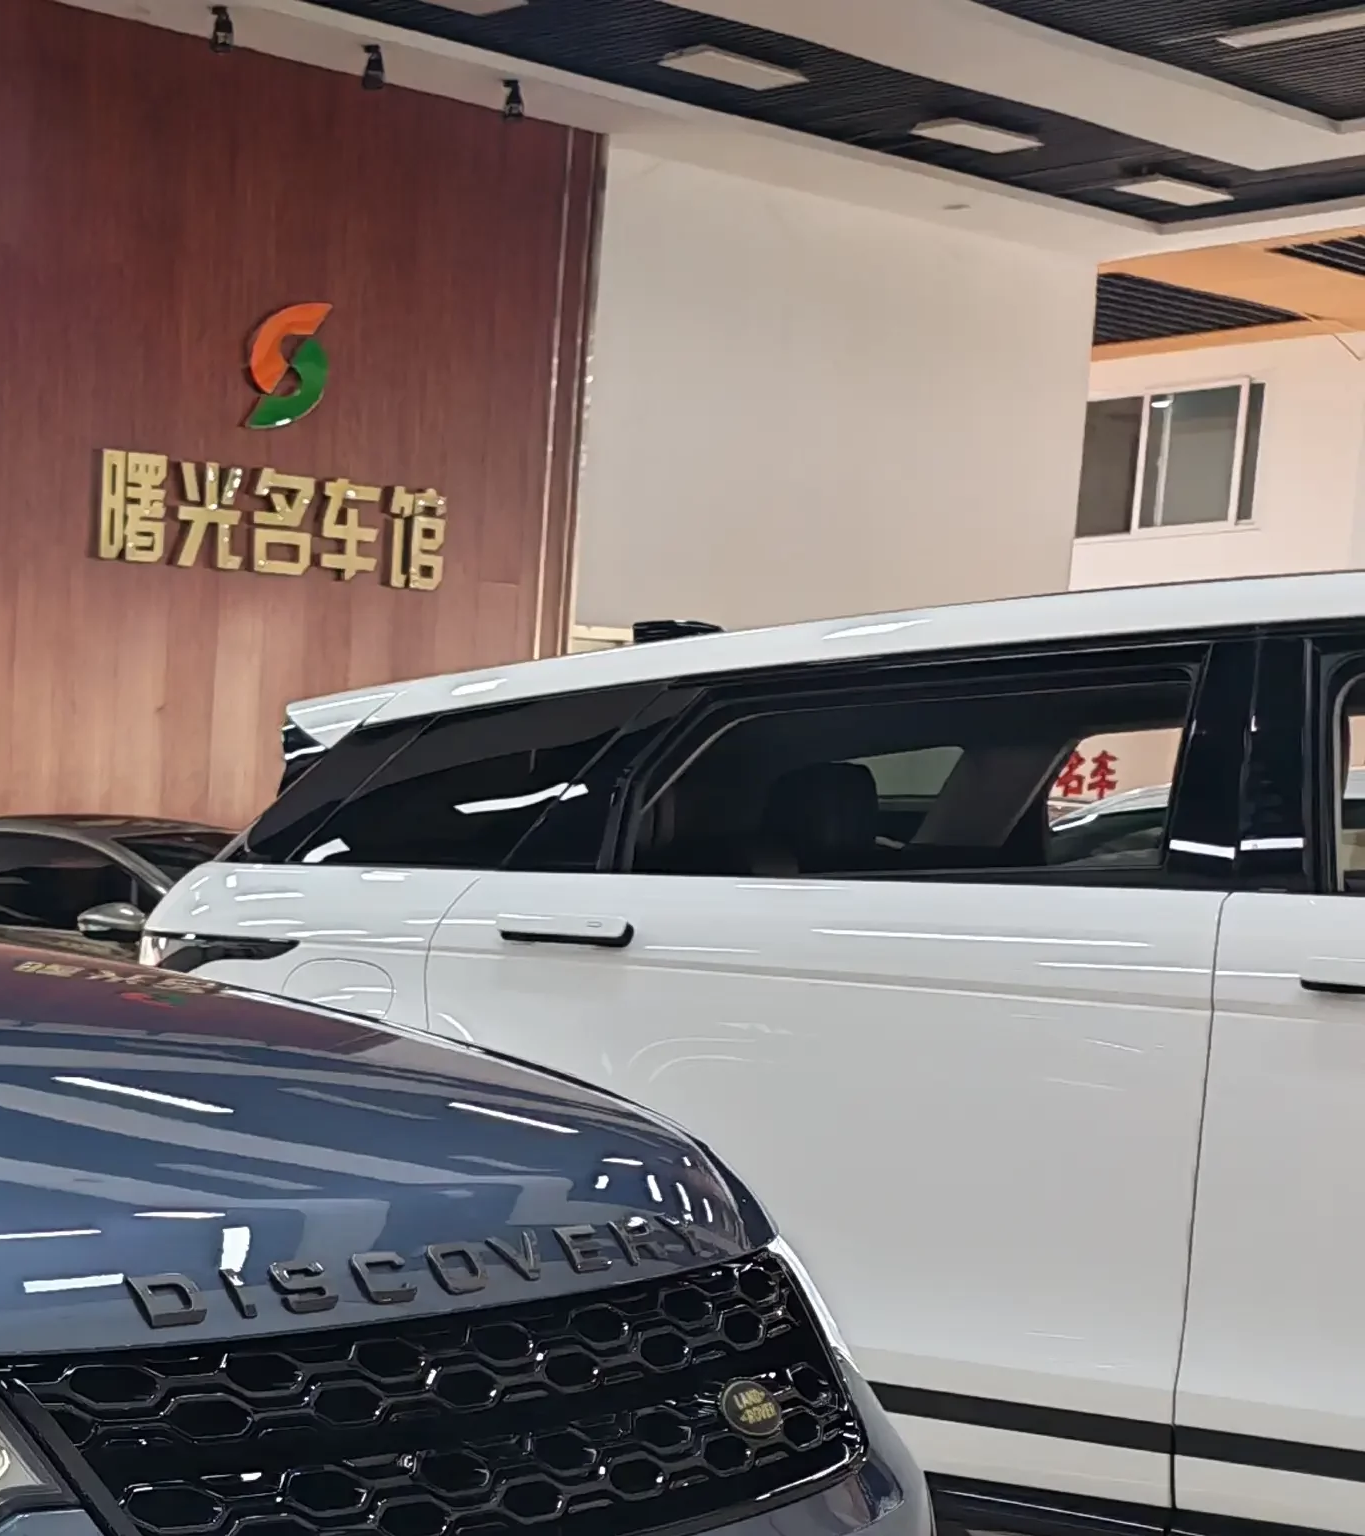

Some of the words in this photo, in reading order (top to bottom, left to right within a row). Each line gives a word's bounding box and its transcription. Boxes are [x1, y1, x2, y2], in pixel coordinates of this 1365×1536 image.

[99, 448, 447, 591] 曙光名车馆
[126, 1212, 709, 1329] DISCOVERY
